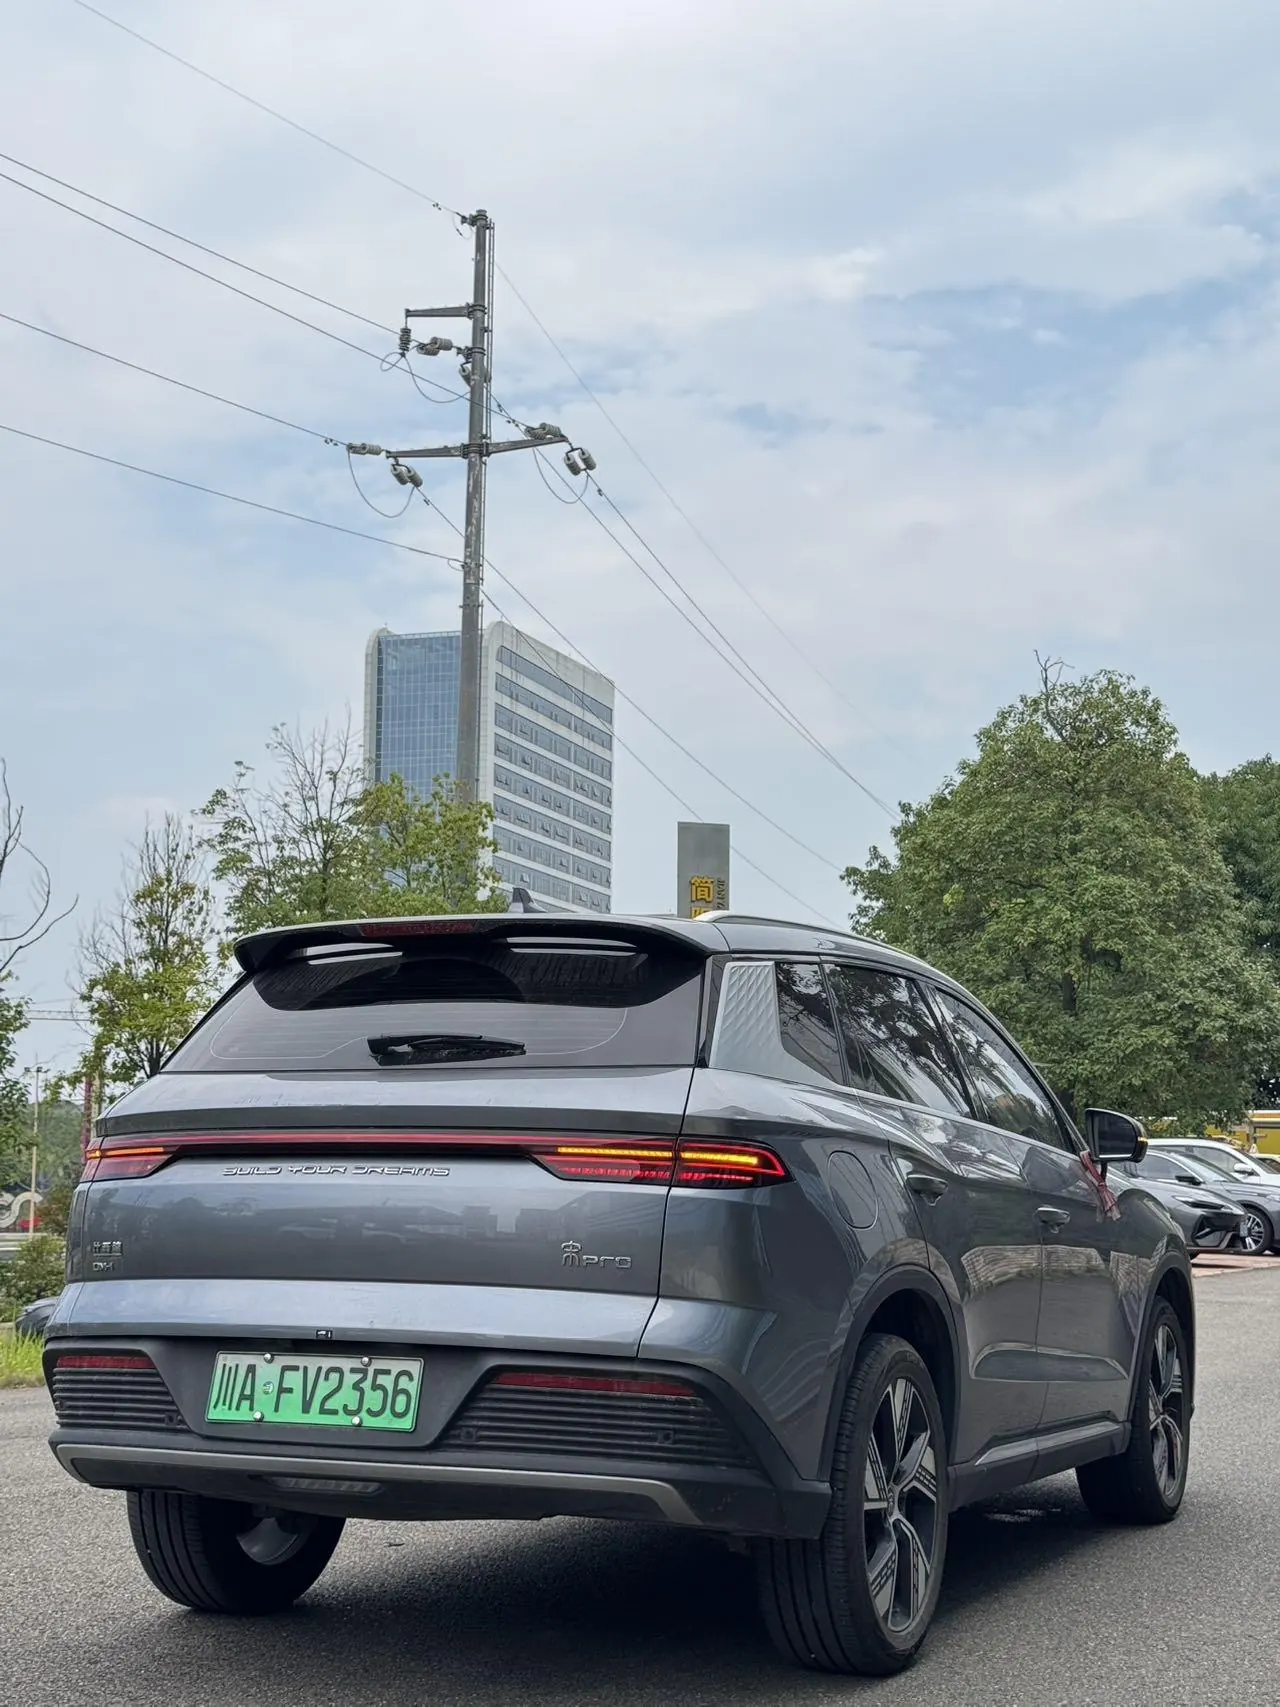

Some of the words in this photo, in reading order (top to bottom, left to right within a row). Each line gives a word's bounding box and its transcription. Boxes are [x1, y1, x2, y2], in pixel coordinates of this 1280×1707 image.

[222, 1166, 282, 1176] BUILD
[288, 1165, 346, 1175] YOUR
[351, 1165, 450, 1177] DREAMS
